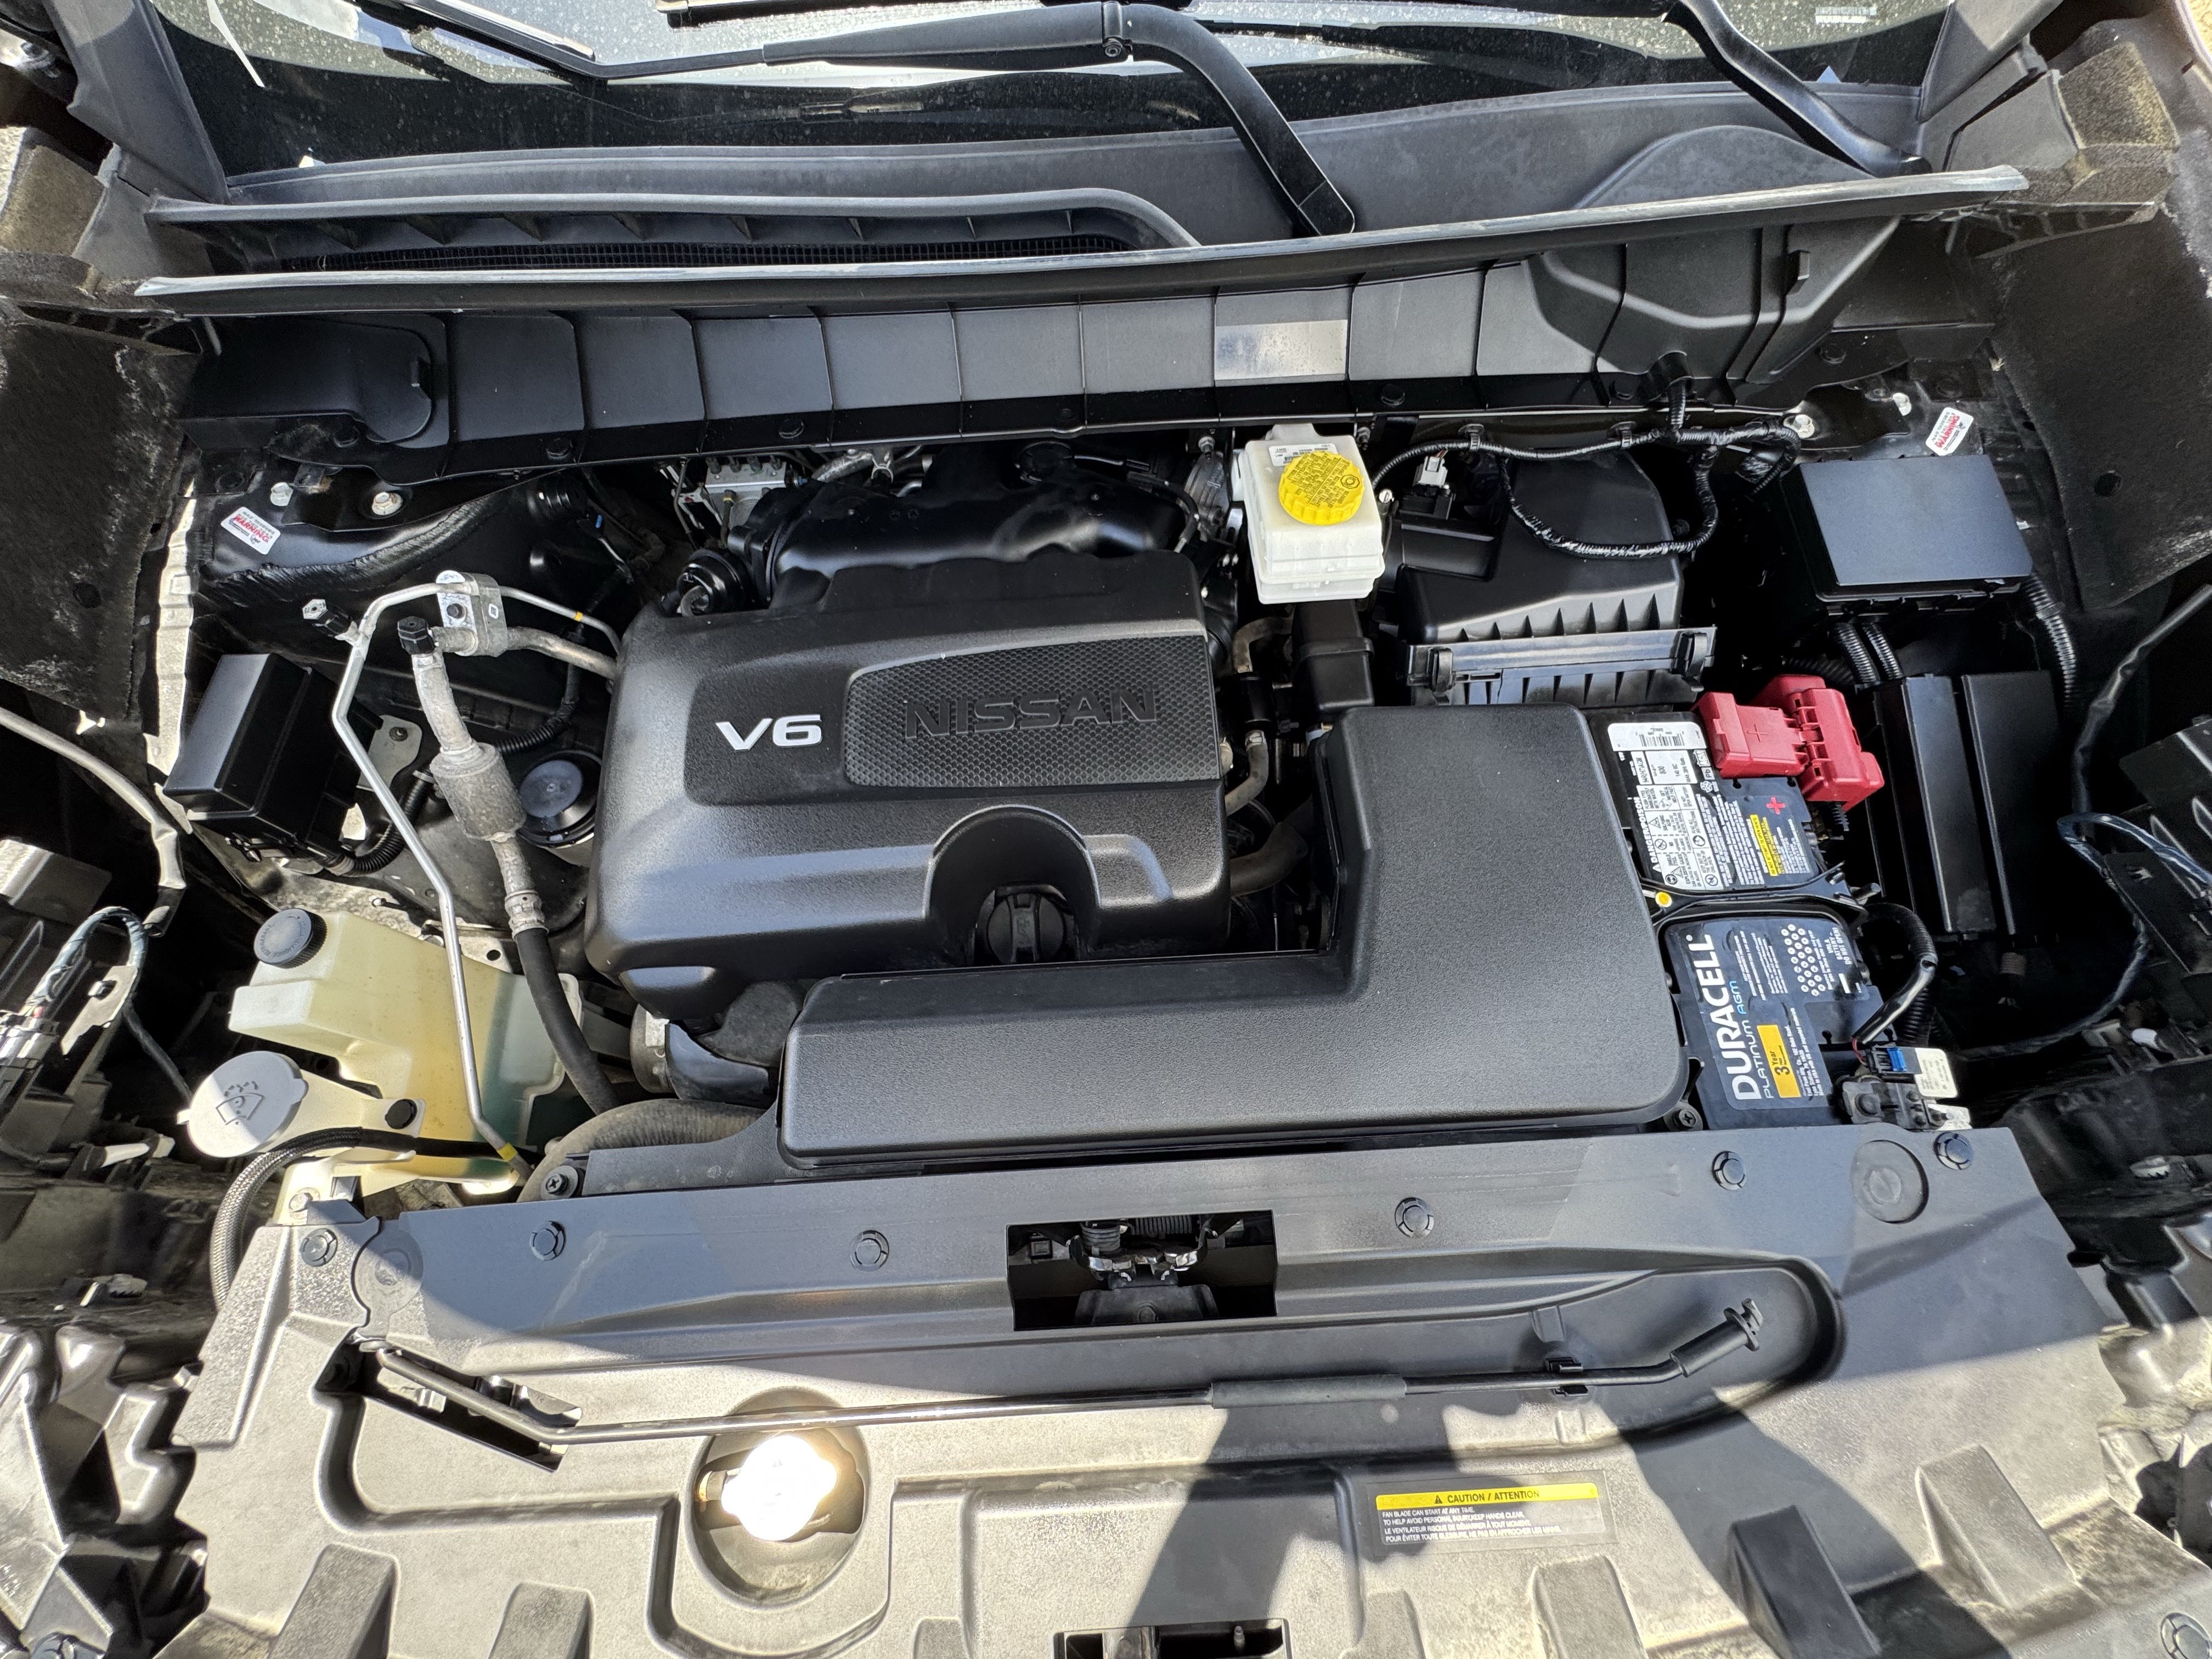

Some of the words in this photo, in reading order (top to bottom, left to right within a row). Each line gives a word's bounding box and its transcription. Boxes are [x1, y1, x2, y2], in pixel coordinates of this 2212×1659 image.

[234, 516, 269, 543] WARNING
[904, 686, 1158, 740] NISSAN
[715, 714, 822, 751] V6
[1696, 750, 1708, 765] AGM
[1704, 769, 1712, 777] Pb
[1632, 797, 1658, 863] DANGER/POISON
[1829, 935, 1843, 960] BATTERY
[1838, 944, 1848, 956] NOT
[1843, 956, 1852, 965] DO
[1728, 980, 1747, 1014] AGM
[1694, 934, 1762, 1100] DURACELL
[1741, 1019, 1774, 1099] PLATINUM
[1769, 1050, 1779, 1065] Year
[1774, 1066, 1790, 1076] 3
[1447, 1493, 1485, 1504] CAUTION
[1493, 1490, 1539, 1501] ATTENTION
[1392, 1526, 1426, 1534] VENTILATEUR
[1402, 1532, 1420, 1541] ÉVITER
